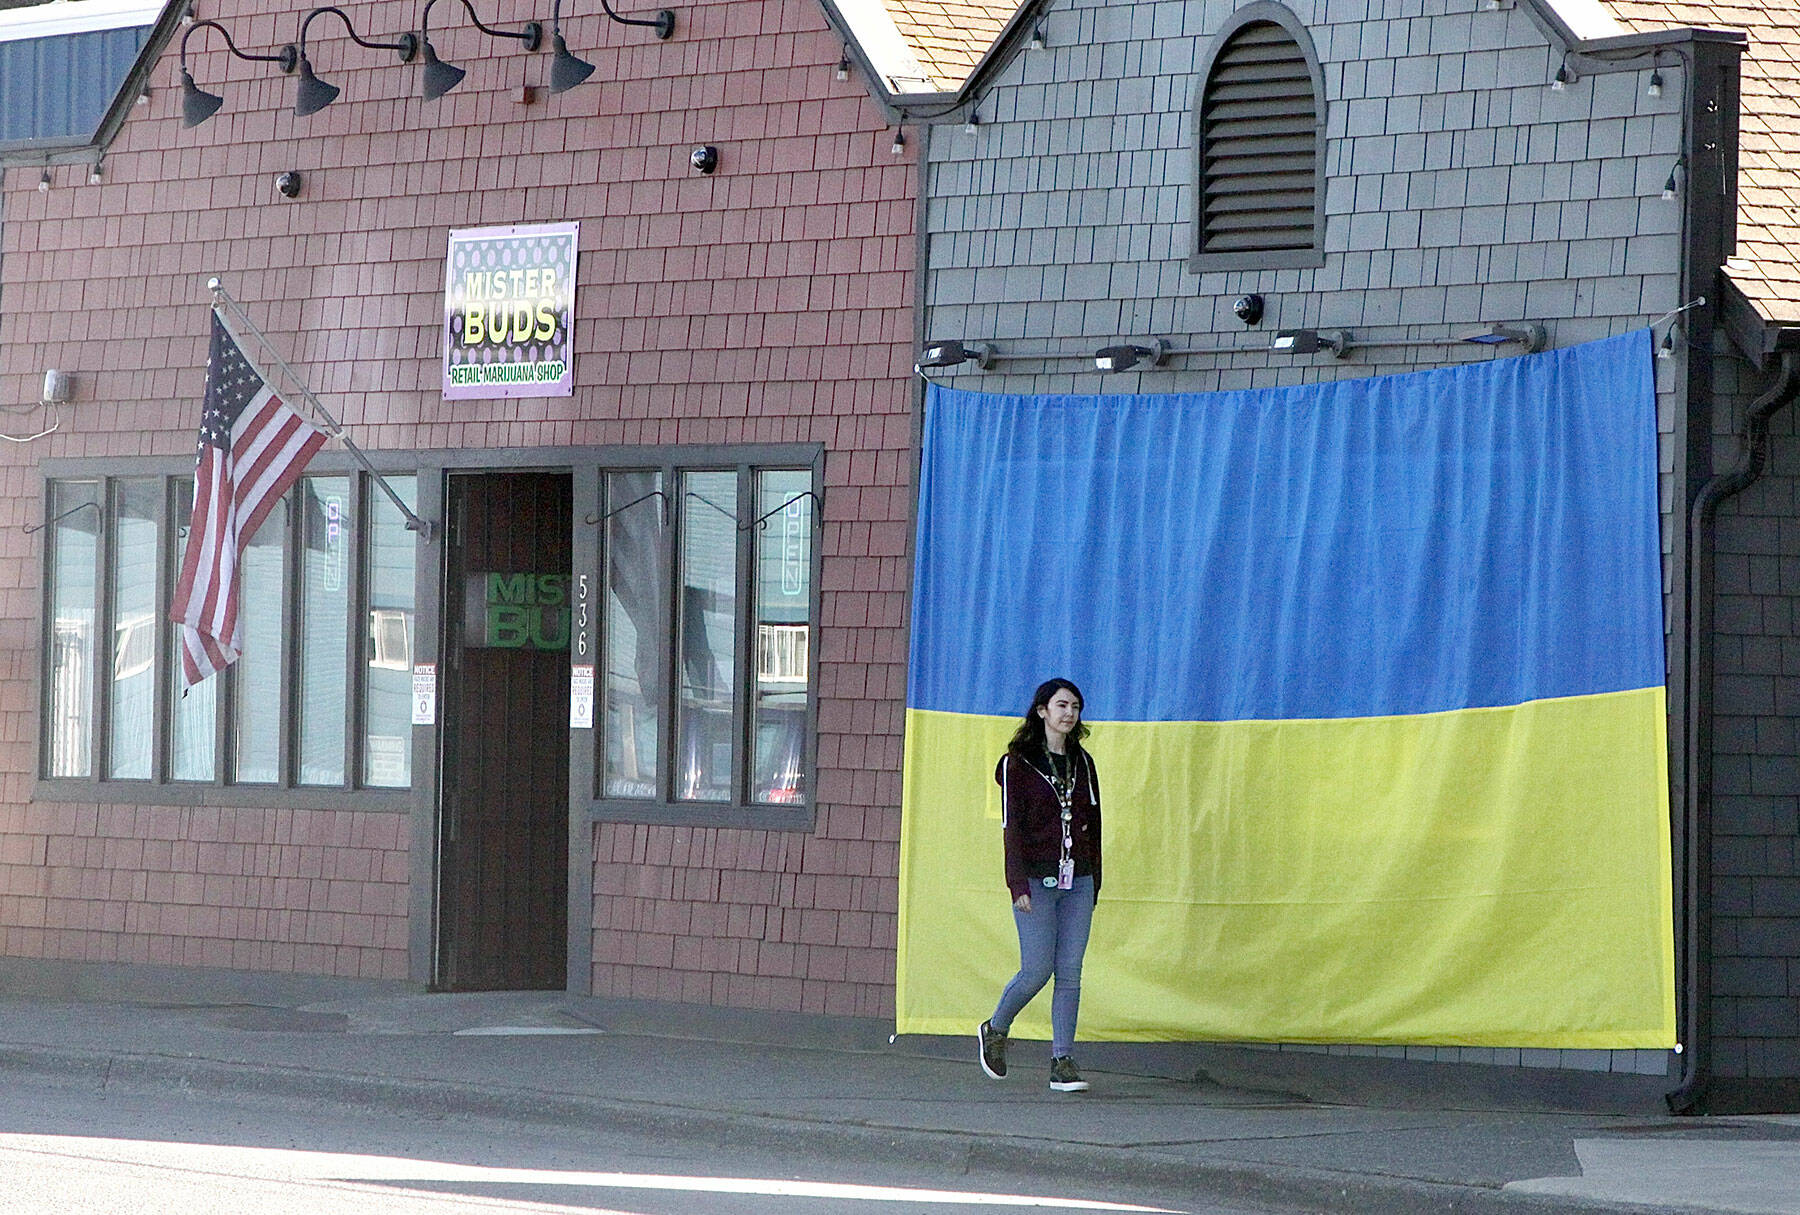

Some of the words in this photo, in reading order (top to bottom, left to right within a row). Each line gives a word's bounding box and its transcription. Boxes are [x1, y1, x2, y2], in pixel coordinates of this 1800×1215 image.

[466, 268, 556, 300] MISTER
[464, 299, 556, 344] BUDS
[451, 367, 480, 384] RETAIL
[484, 365, 534, 383] MARIJUANA
[537, 363, 564, 382] SHOP
[785, 497, 800, 589] OPEN
[487, 572, 571, 604] MIS
